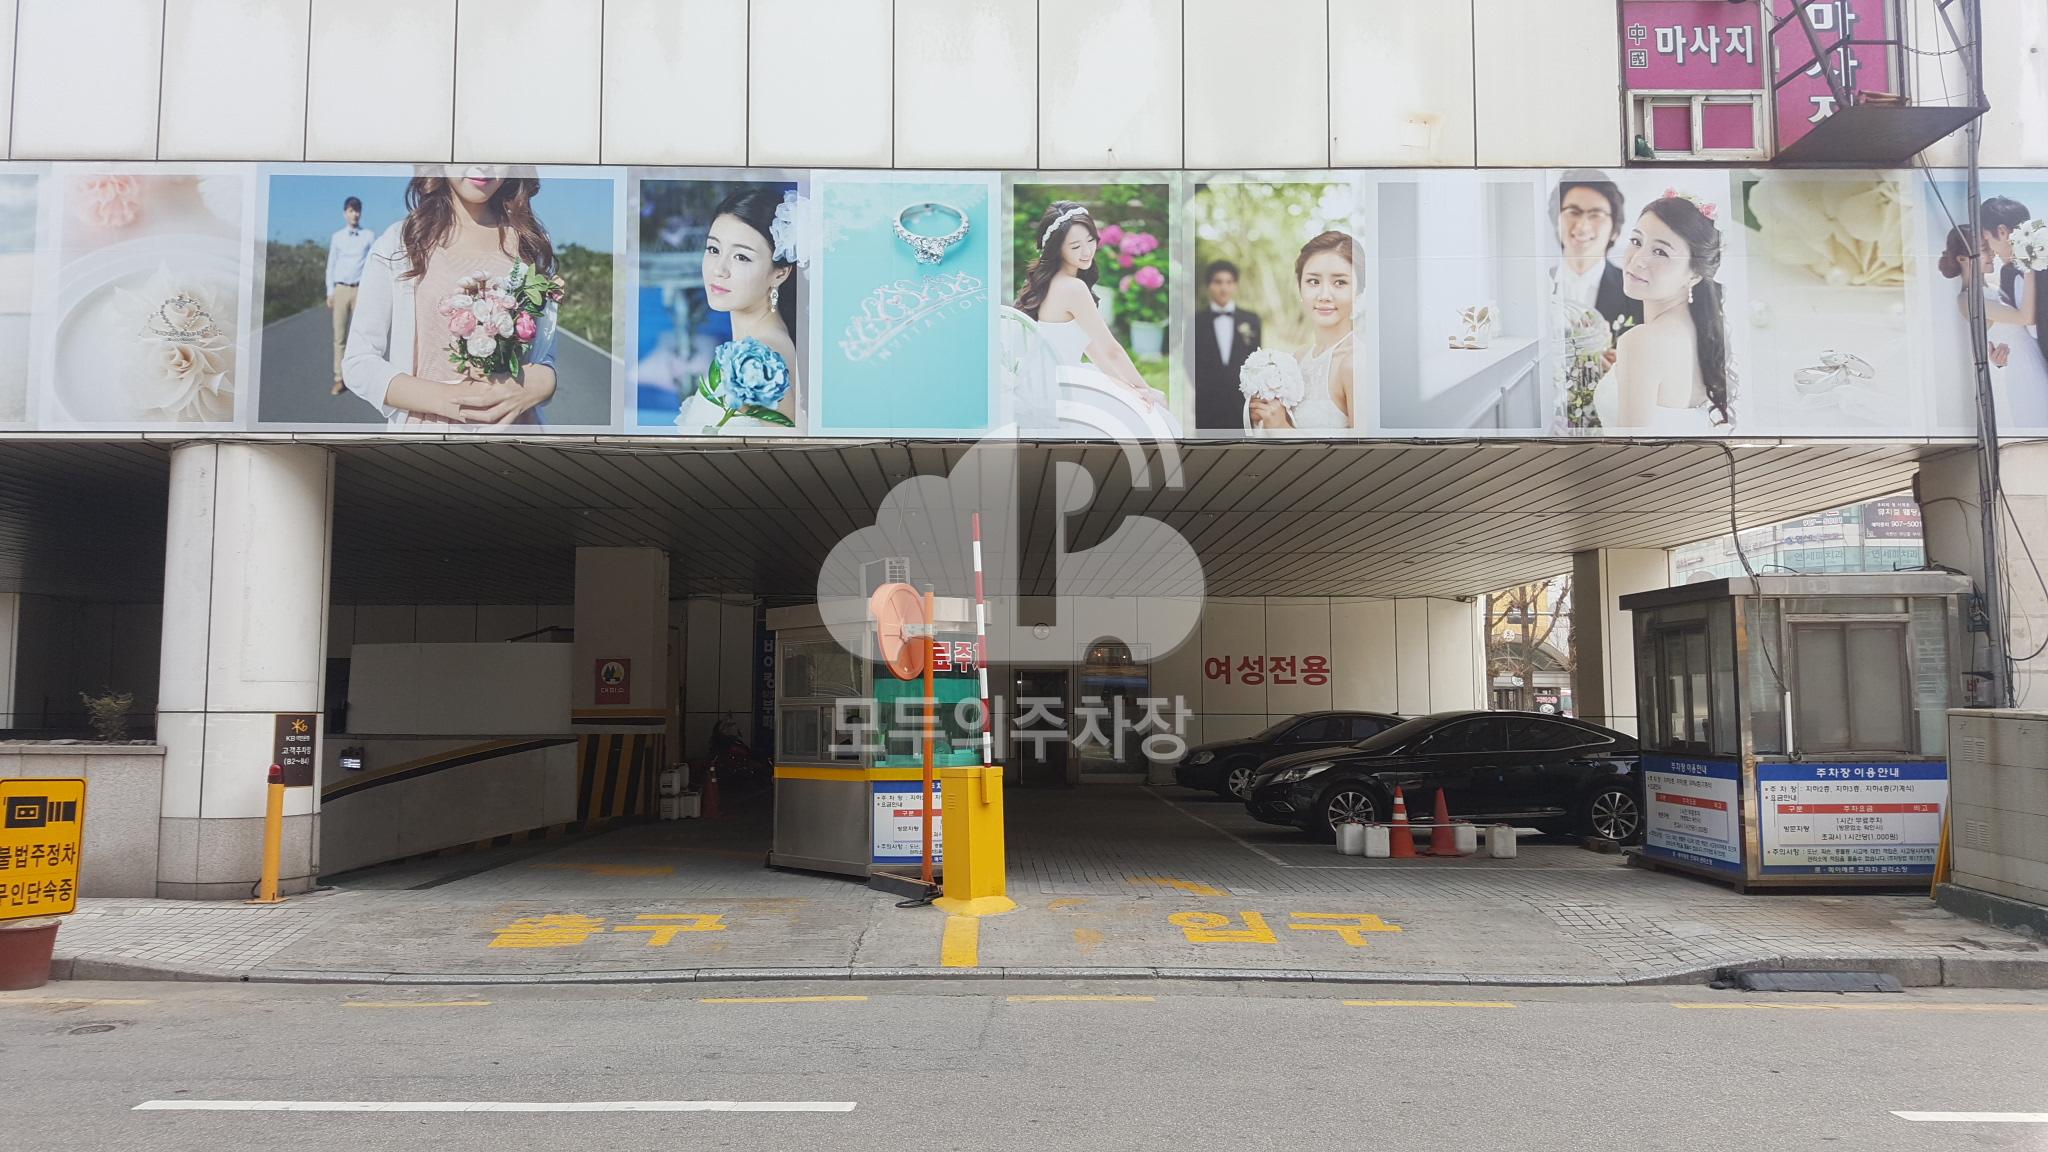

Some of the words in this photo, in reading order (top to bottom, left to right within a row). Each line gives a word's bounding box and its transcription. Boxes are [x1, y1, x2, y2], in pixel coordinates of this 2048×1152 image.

[1654, 25, 1754, 65] 마사지
[1204, 655, 1330, 685] 여성전용
[281, 747, 311, 755] 고객주차장
[1816, 768, 1850, 778] 주차장
[1854, 767, 1900, 778] 이용안내
[1843, 805, 1873, 813] 주차요금
[1166, 911, 1403, 947] 입구
